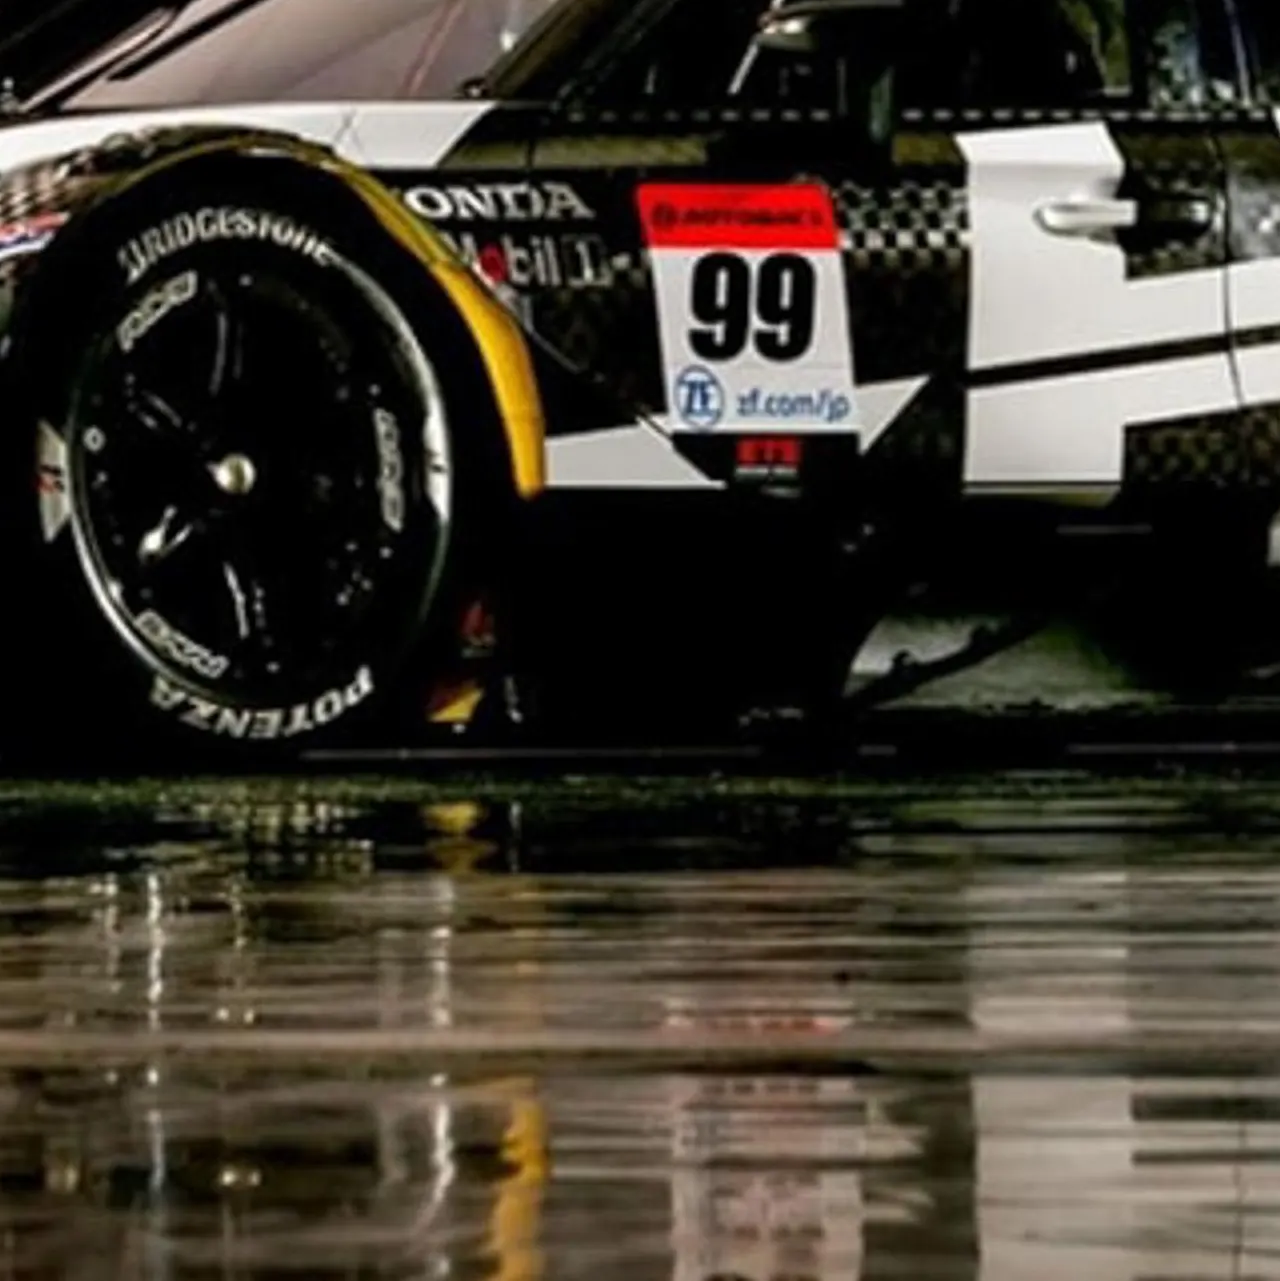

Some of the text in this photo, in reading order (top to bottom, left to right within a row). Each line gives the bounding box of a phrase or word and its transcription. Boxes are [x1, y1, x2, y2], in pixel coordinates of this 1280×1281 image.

[388, 181, 596, 219] ONDA
[688, 251, 817, 362] 99
[736, 387, 852, 423] zf.com/jp
[149, 664, 373, 738] POTENZA
